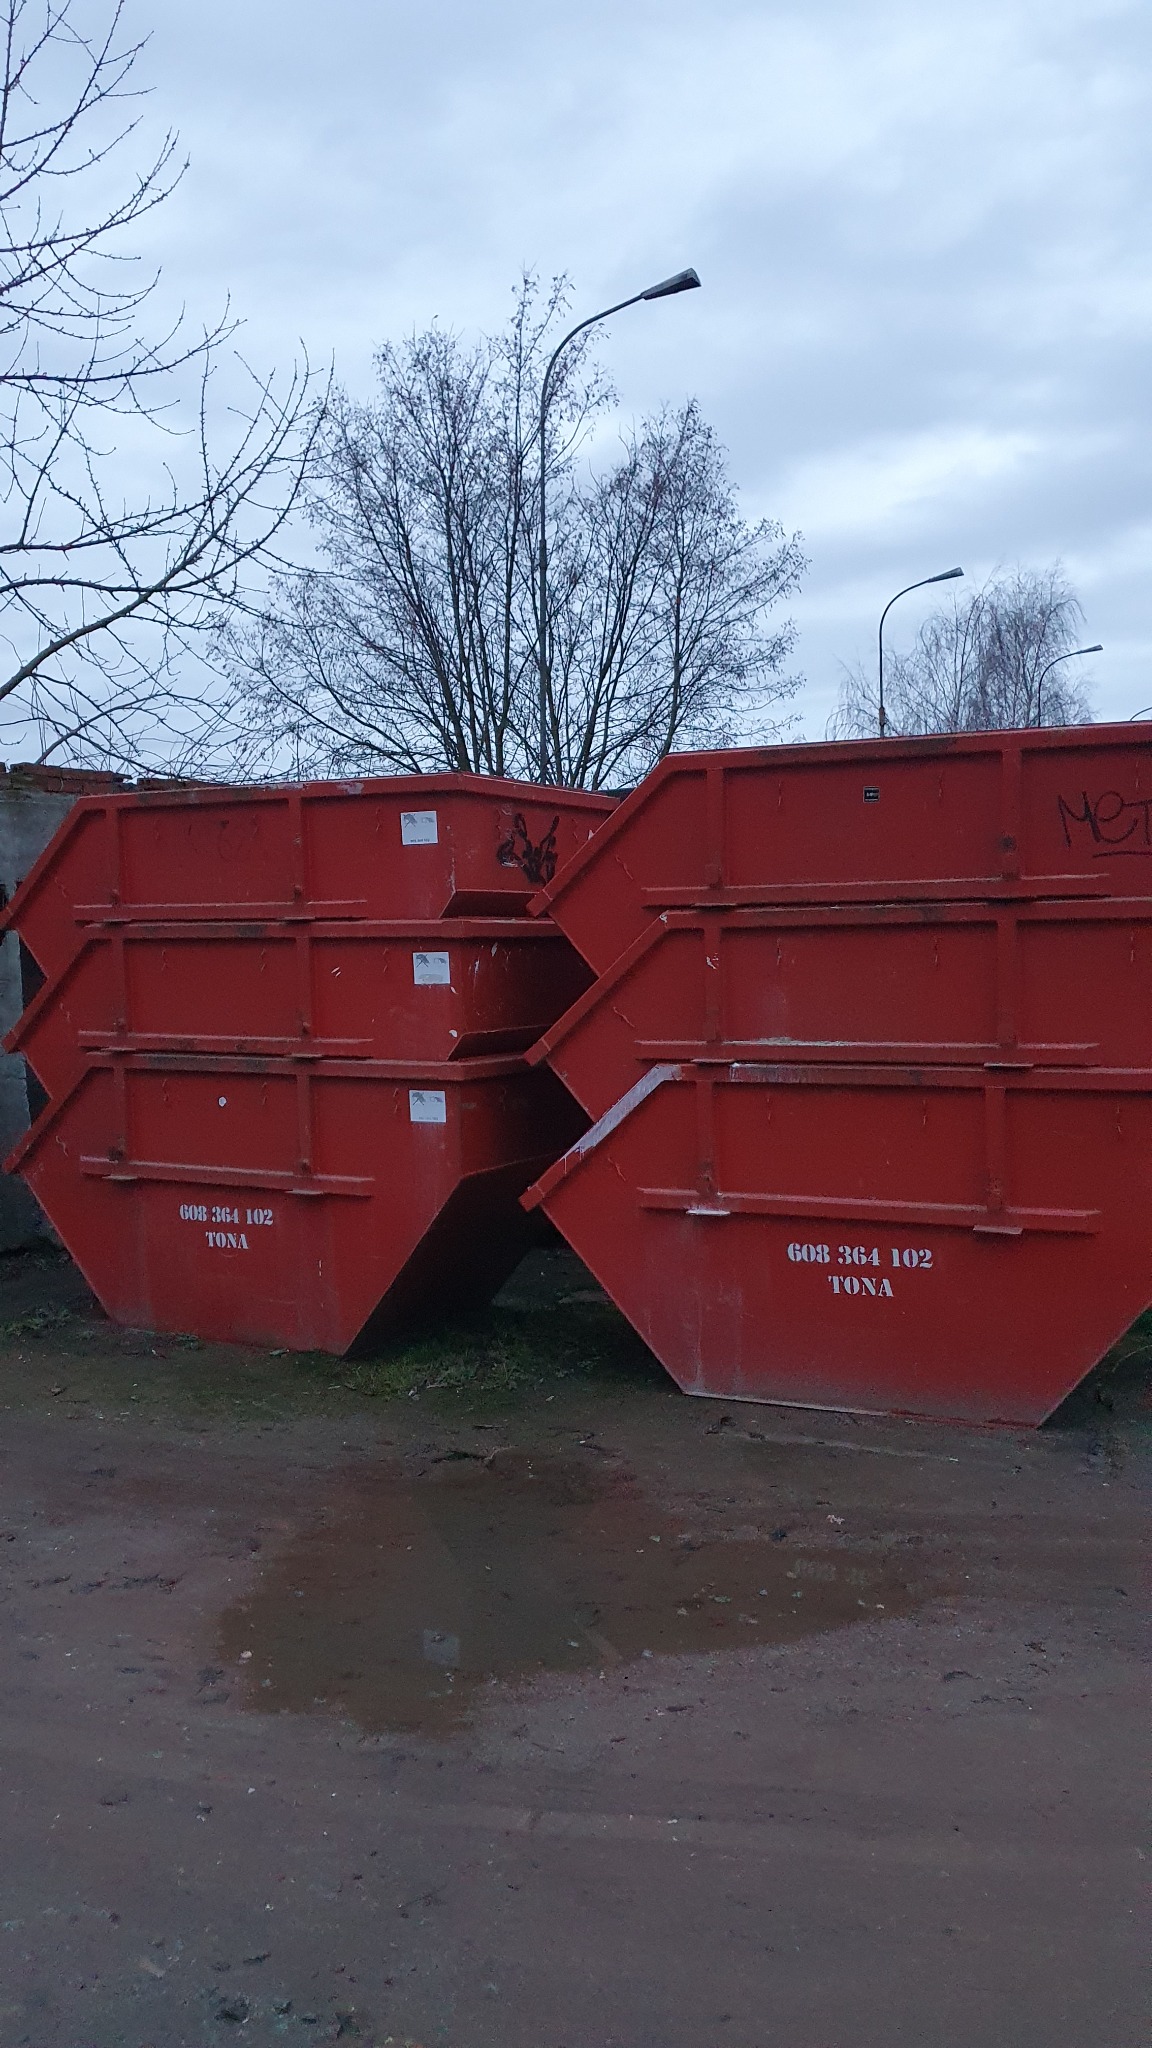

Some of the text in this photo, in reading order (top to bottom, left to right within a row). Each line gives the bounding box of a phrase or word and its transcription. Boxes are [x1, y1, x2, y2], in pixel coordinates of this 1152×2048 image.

[179, 1204, 274, 1226] 608 364 102
[205, 1231, 249, 1250] TONA
[787, 1243, 934, 1269] 608 364 102
[828, 1275, 894, 1297] TONA
